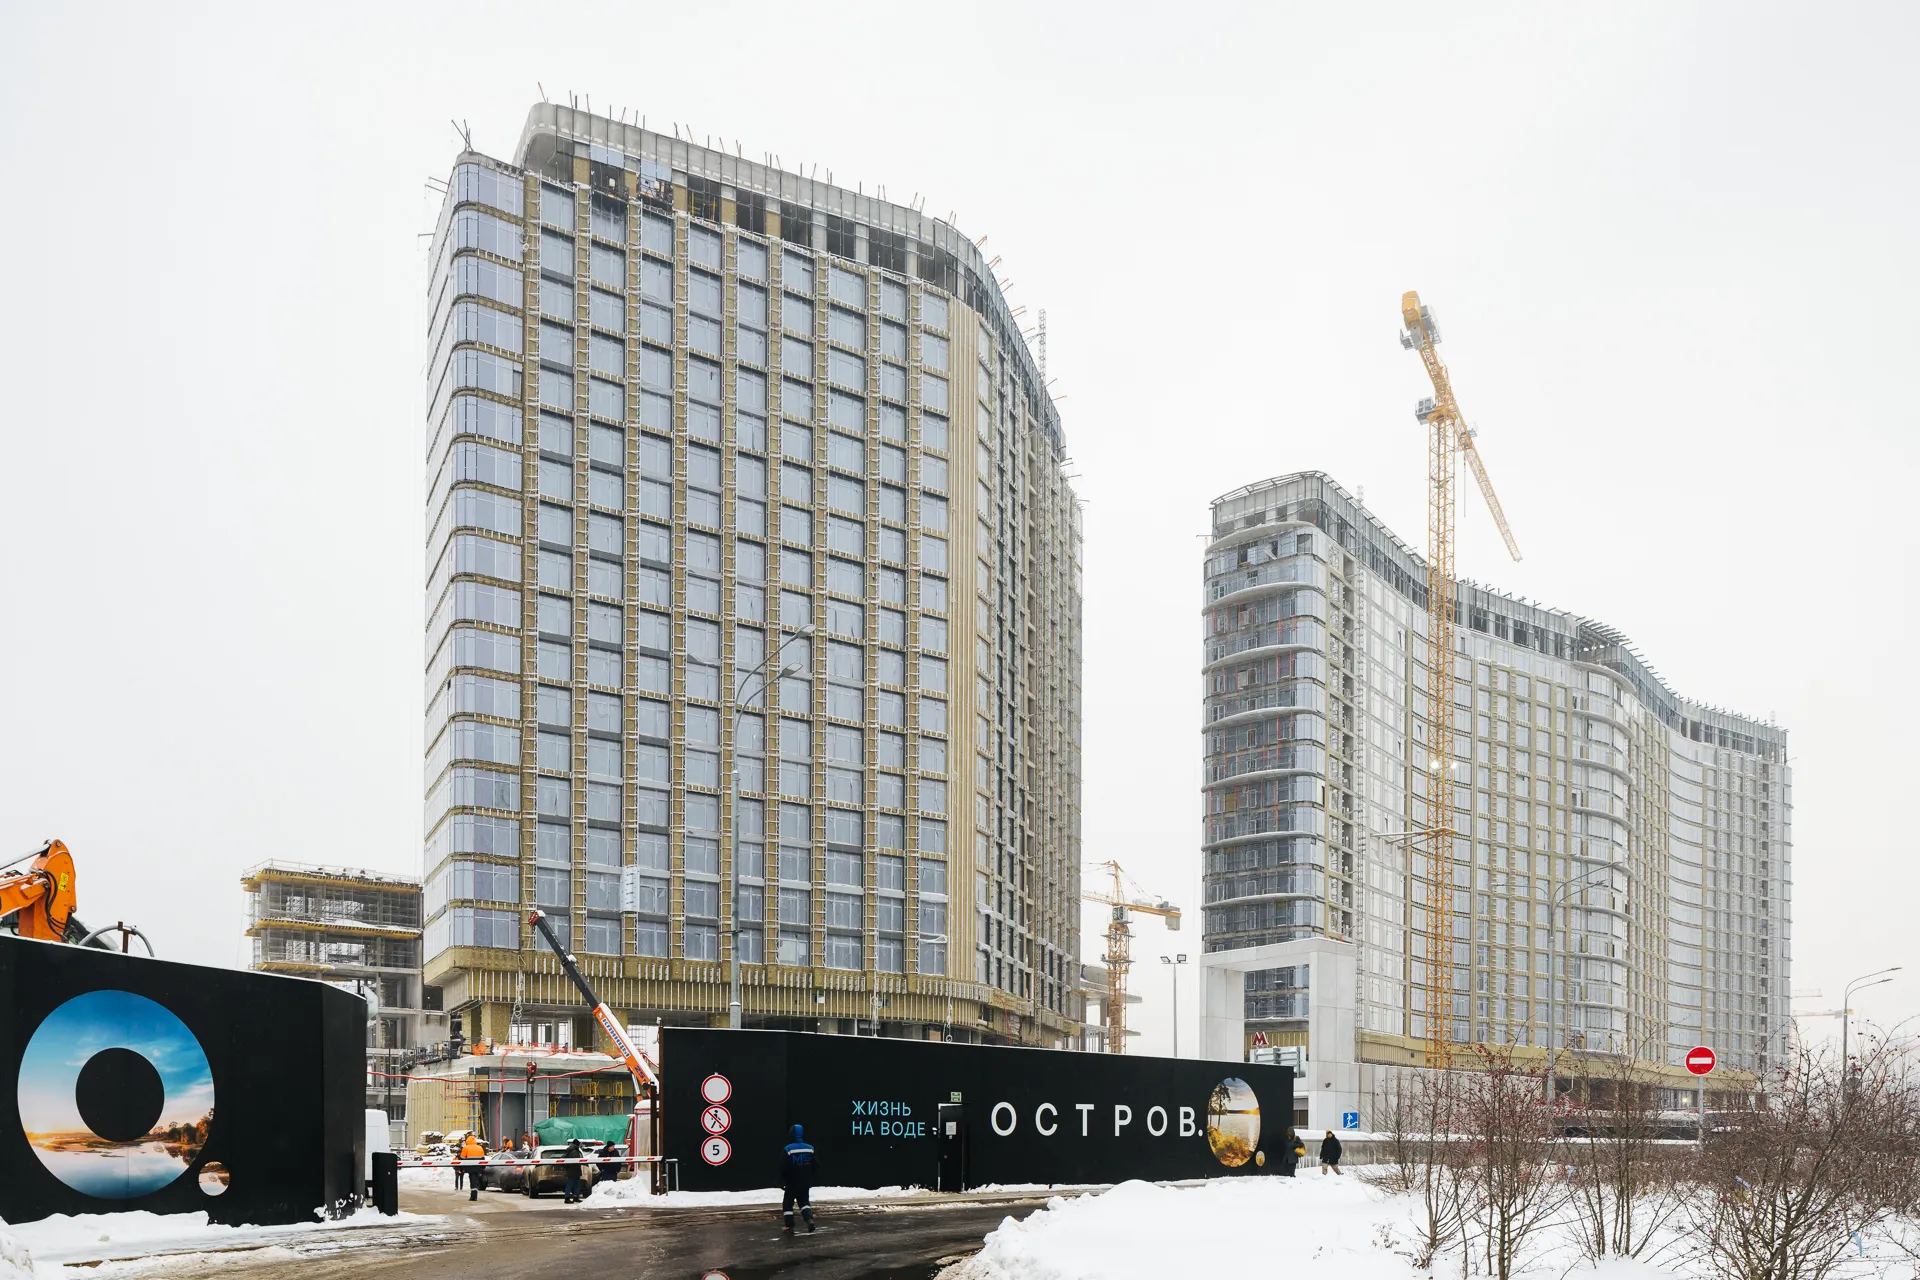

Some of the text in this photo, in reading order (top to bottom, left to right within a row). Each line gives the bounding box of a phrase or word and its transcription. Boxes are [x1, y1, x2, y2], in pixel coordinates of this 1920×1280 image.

[851, 1100, 912, 1116] ЖИЗНЬ
[990, 1101, 1204, 1137] ОСТРОВ.
[852, 1120, 926, 1139] НА ВОДЕ
[712, 1144, 720, 1156] 5
